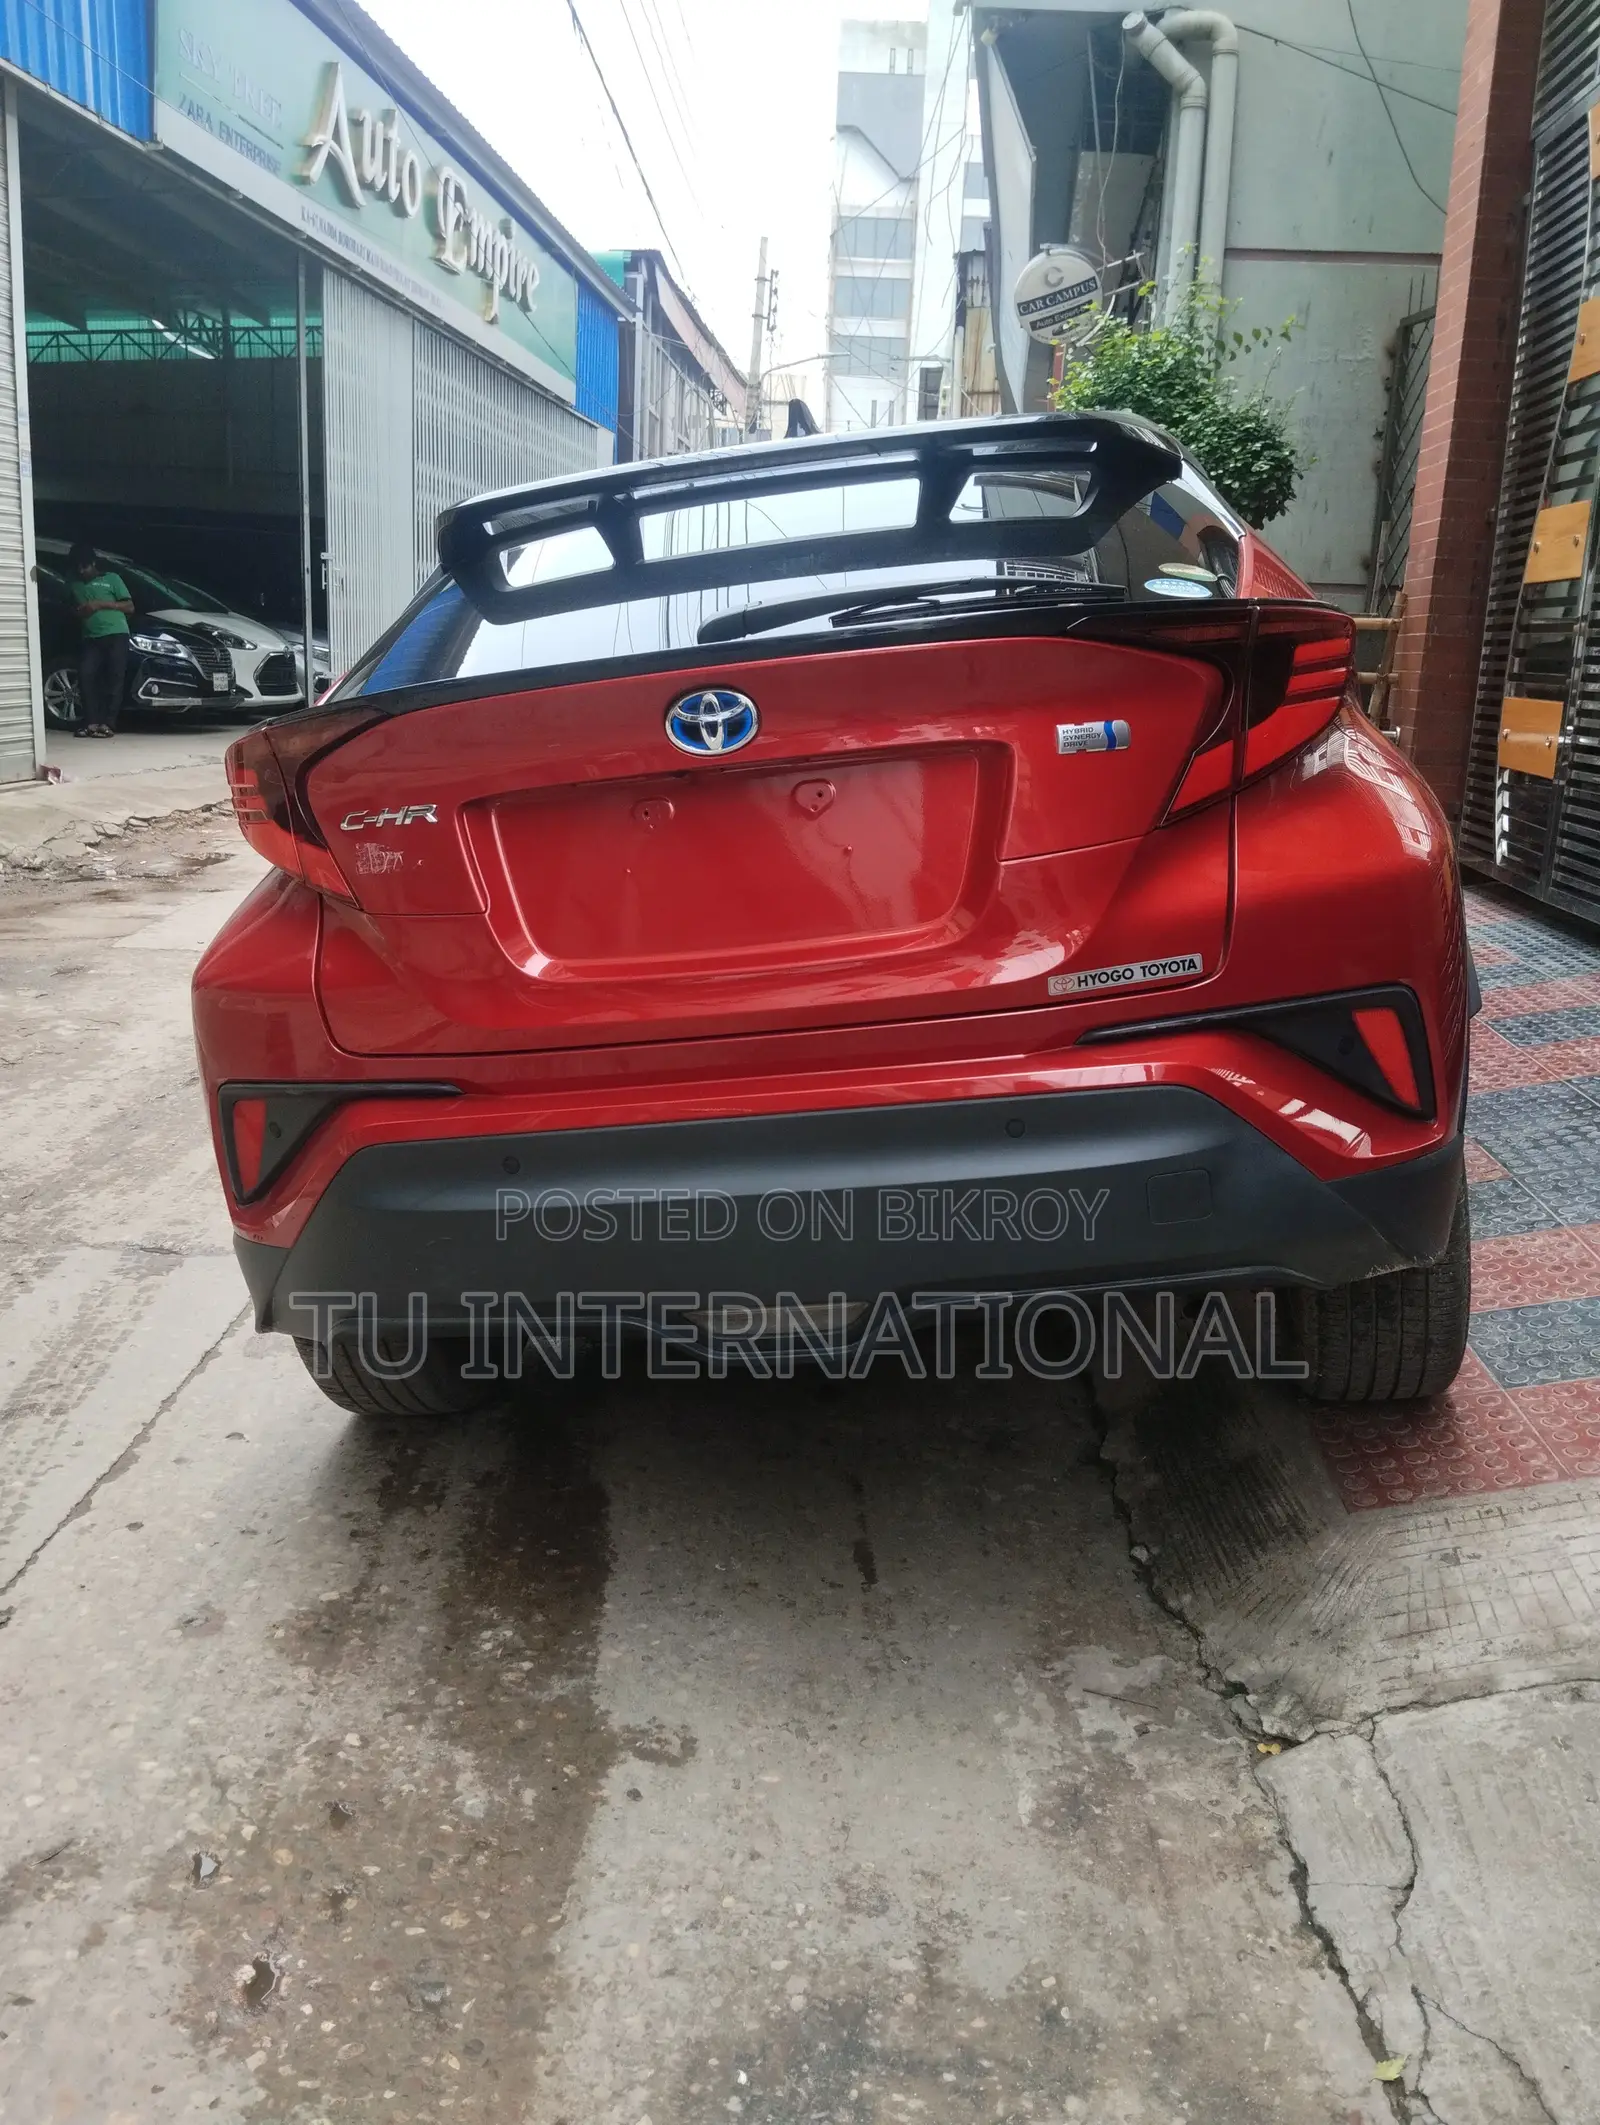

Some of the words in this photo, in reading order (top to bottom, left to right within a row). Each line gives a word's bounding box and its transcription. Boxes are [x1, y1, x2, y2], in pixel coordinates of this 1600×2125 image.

[178, 91, 214, 132] ZARA
[219, 120, 282, 176] ENTERPRISE
[300, 61, 422, 218] Auto
[435, 166, 541, 324] Empire
[1019, 299, 1044, 314] CAR
[1046, 279, 1096, 305] CAMPUS
[1036, 317, 1054, 329] Auto
[1062, 726, 1094, 735] HYBRID
[1063, 732, 1102, 742] SYNERGY
[1063, 740, 1089, 748] DRIVE
[340, 804, 438, 831] C-HR
[1077, 967, 1134, 988] HYOGO
[1139, 958, 1198, 978] TOYOTA
